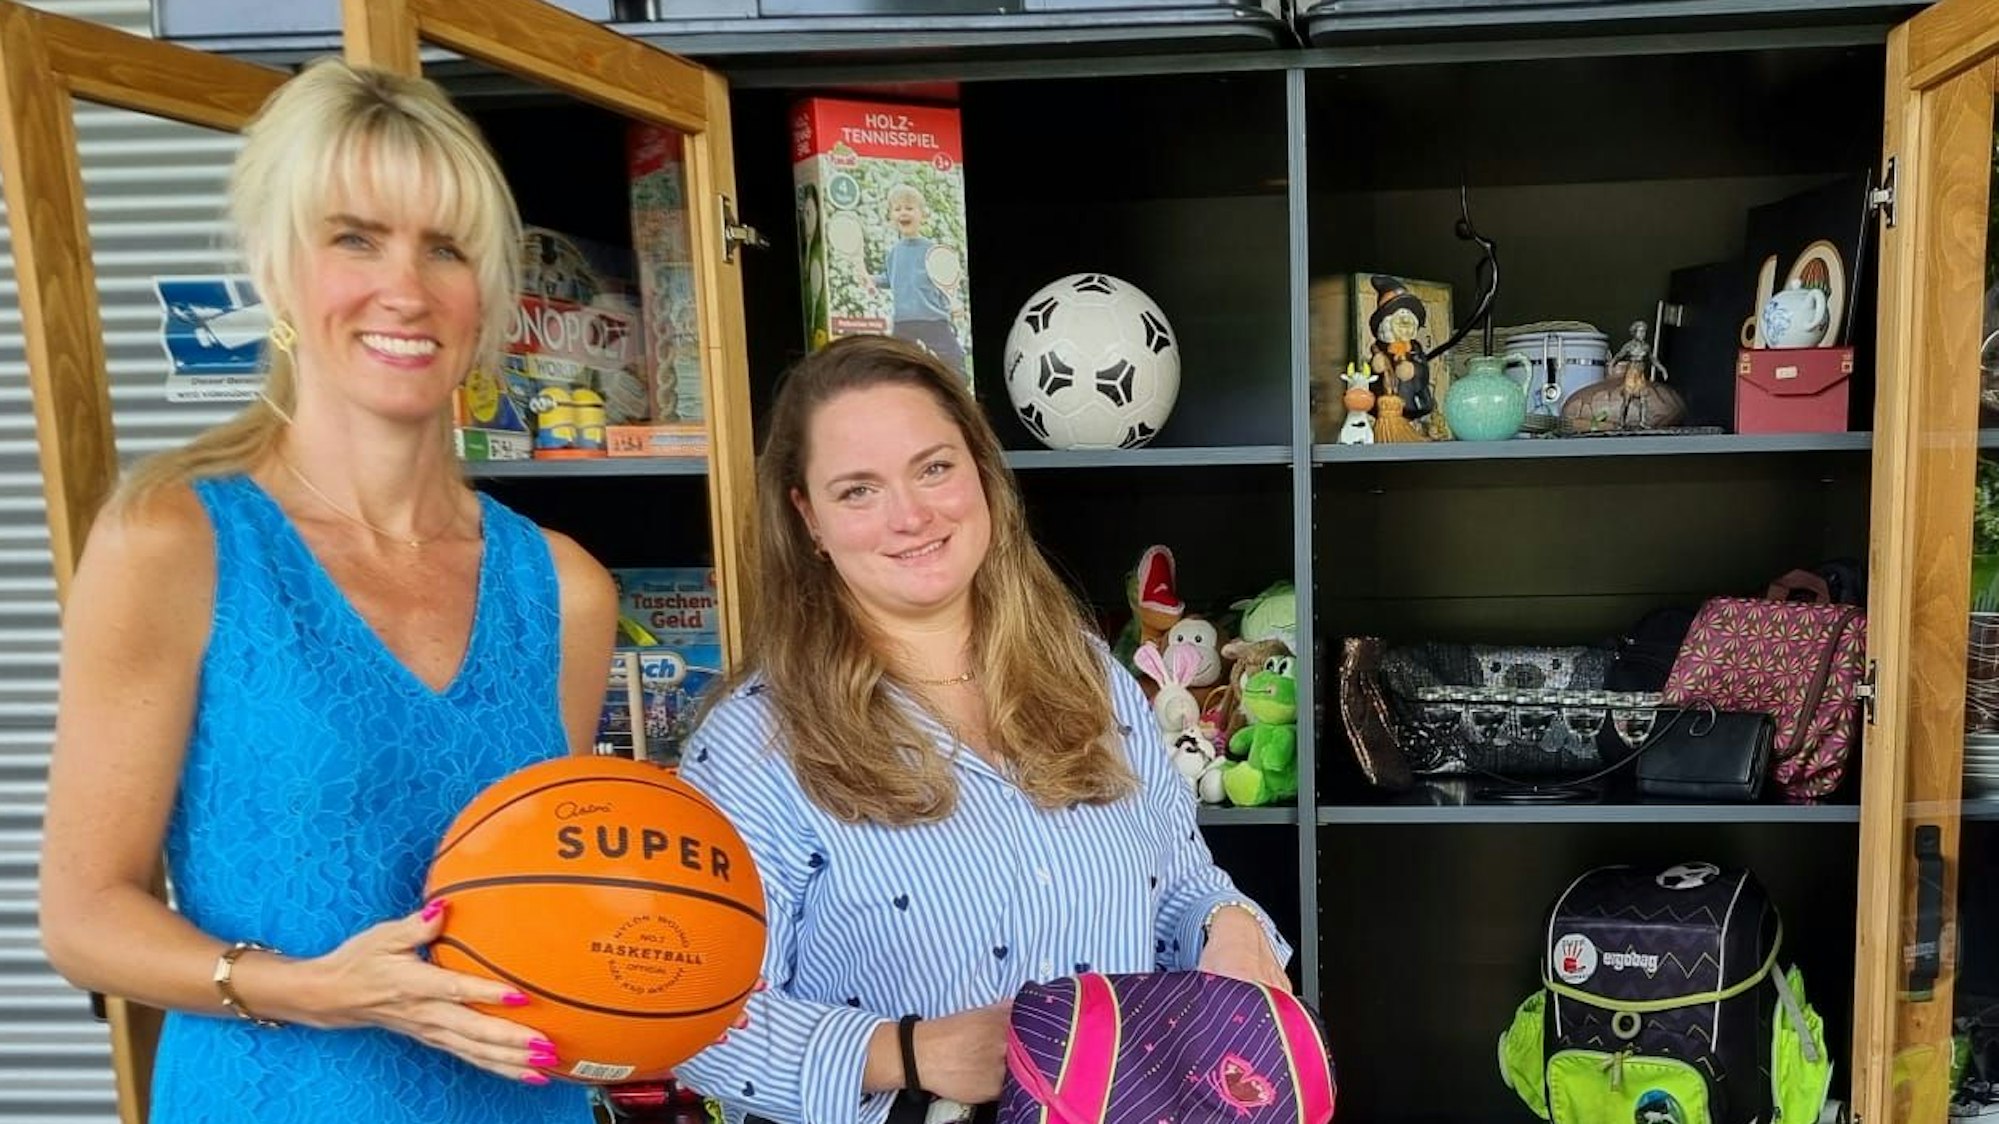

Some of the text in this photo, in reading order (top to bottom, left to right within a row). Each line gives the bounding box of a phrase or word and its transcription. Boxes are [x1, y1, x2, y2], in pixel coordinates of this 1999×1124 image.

[864, 113, 915, 132] HOLZ-
[840, 126, 940, 149] TENNISSPIEL
[504, 305, 629, 362] ONOPOLY
[650, 610, 704, 629] Geld
[557, 825, 731, 883] SUPER
[591, 942, 703, 965] BASKETBALL
[1602, 951, 1659, 973] ergobag
